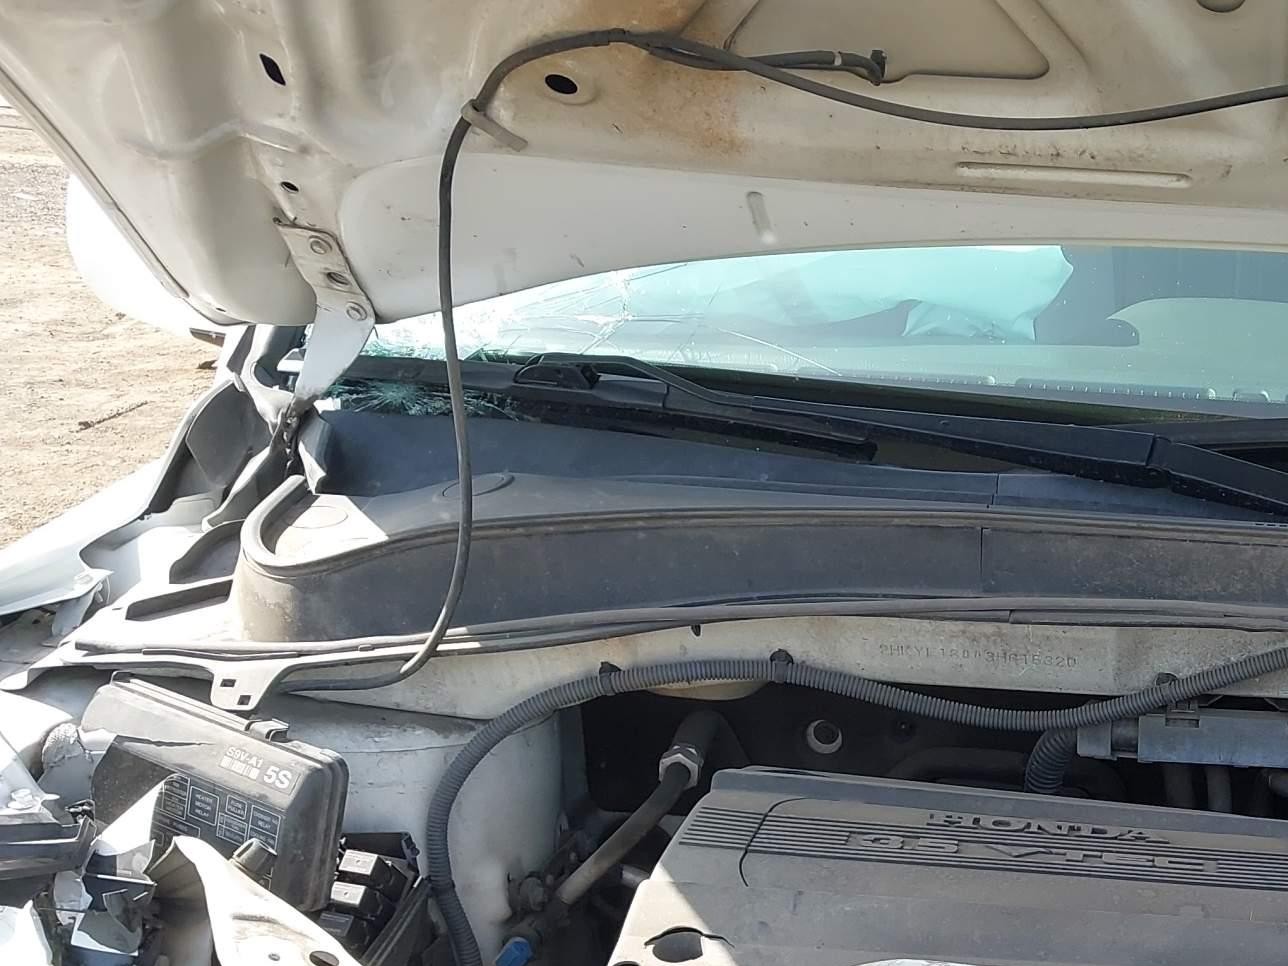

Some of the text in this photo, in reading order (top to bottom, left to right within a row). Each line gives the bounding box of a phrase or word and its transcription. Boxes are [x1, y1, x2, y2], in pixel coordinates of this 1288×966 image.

[225, 746, 264, 768] S9V-A1
[263, 766, 294, 789] 5S
[926, 812, 1170, 845] HONDA
[985, 844, 1218, 872] VTEC
